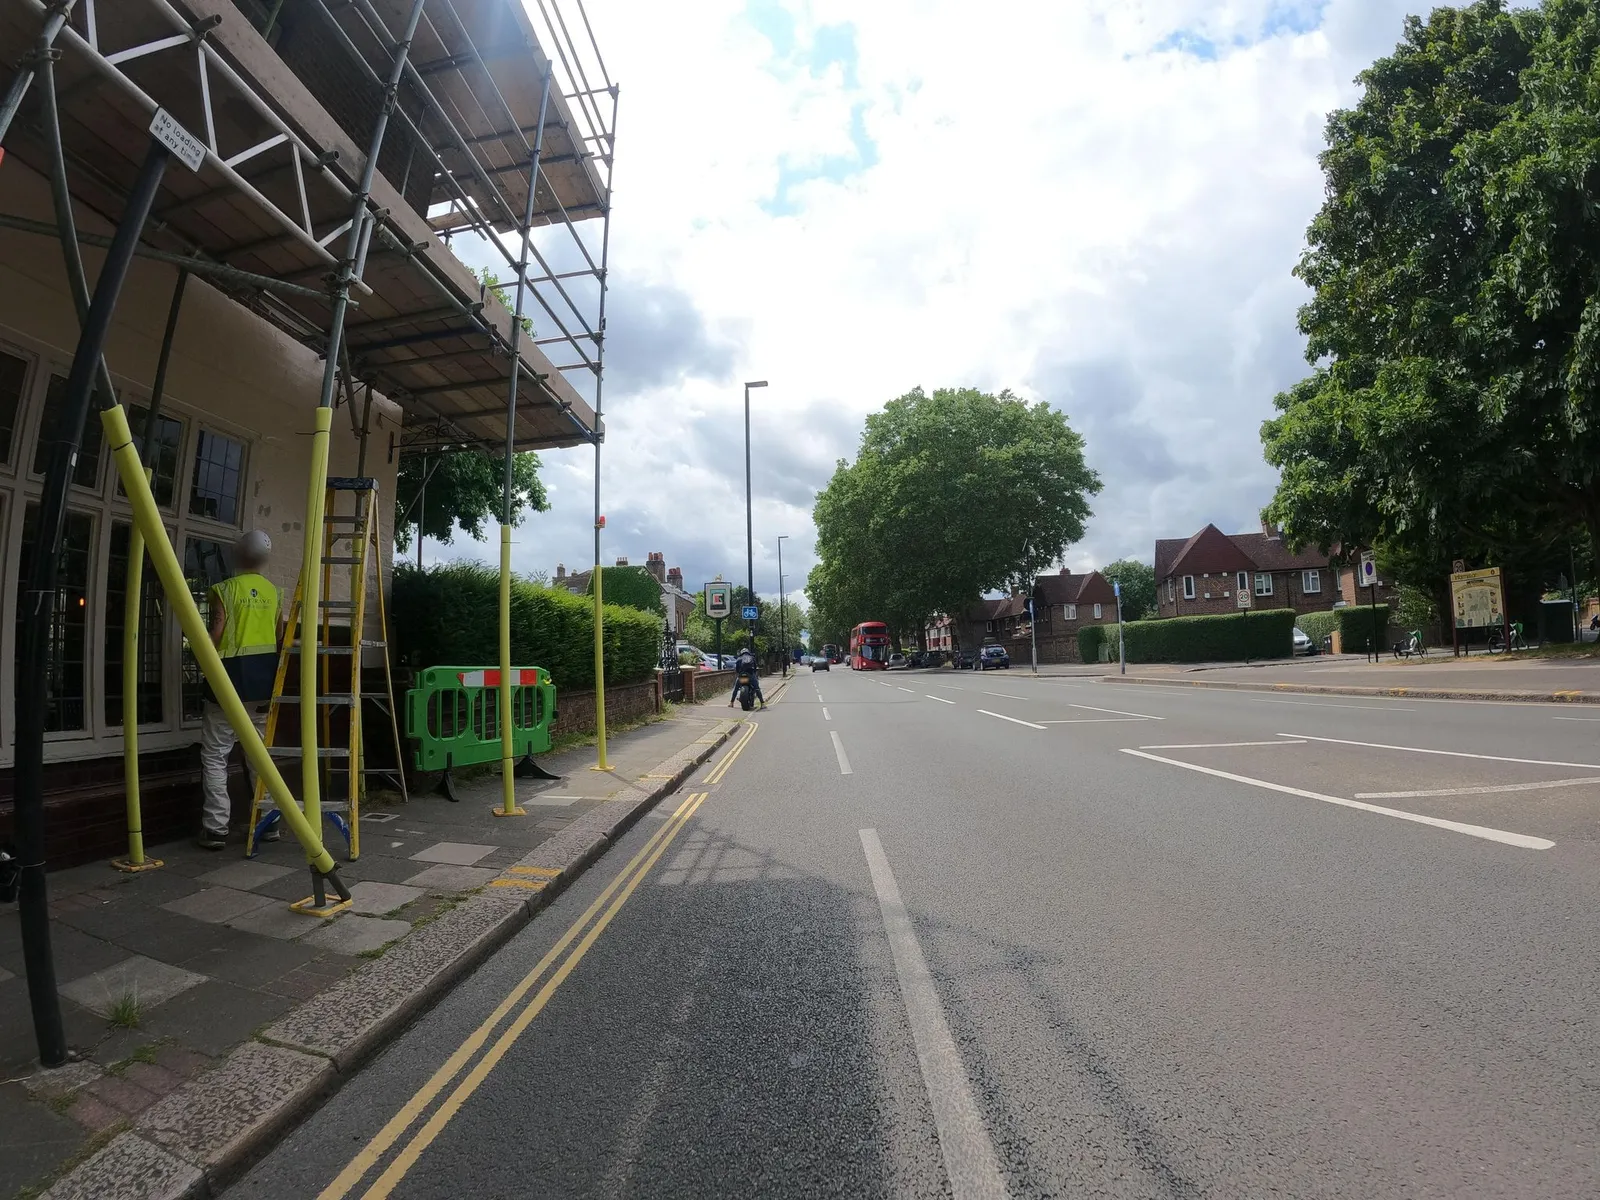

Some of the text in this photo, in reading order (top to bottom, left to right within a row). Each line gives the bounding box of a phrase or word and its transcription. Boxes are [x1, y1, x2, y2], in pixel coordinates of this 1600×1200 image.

[154, 124, 164, 135] at
[164, 133, 179, 149] any
[159, 115, 201, 157] No loading
